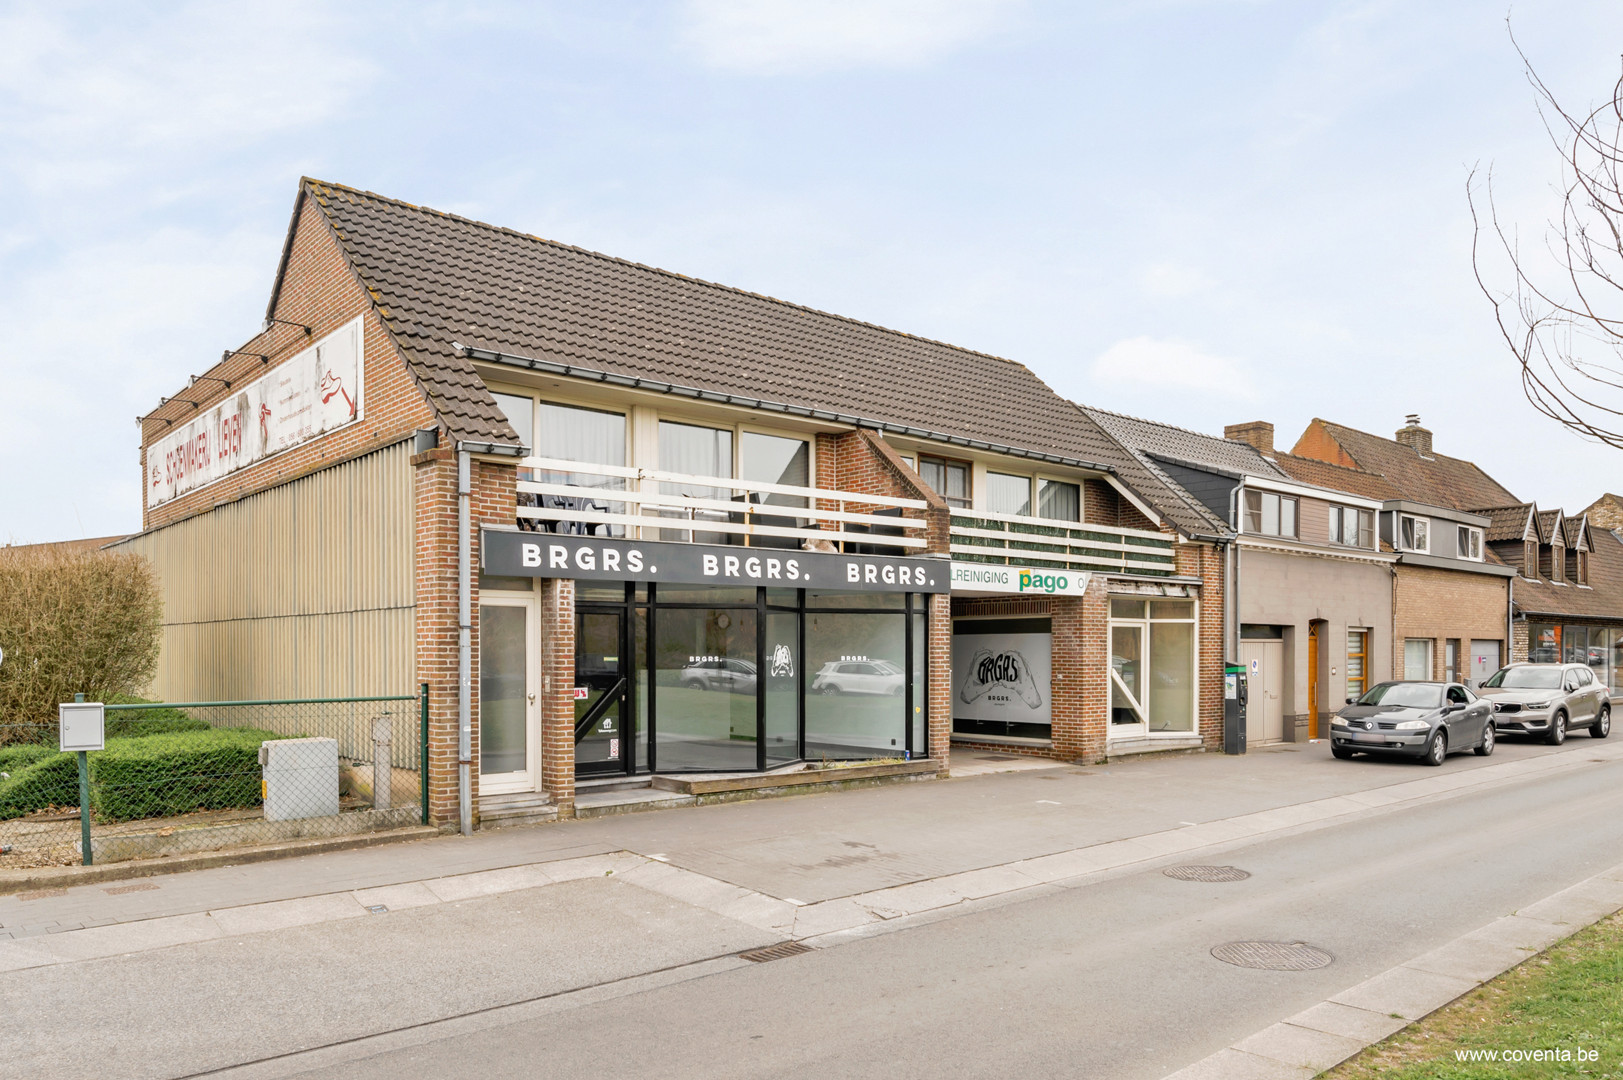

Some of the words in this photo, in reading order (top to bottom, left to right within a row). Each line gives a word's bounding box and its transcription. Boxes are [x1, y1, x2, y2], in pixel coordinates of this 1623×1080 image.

[218, 411, 242, 459] LIEVEN
[522, 543, 658, 574] BRGRS.
[703, 554, 810, 581] BRGRS.
[846, 563, 935, 587] BRGRS.
[1019, 572, 1068, 593] pago
[978, 653, 1018, 685] BRGRS
